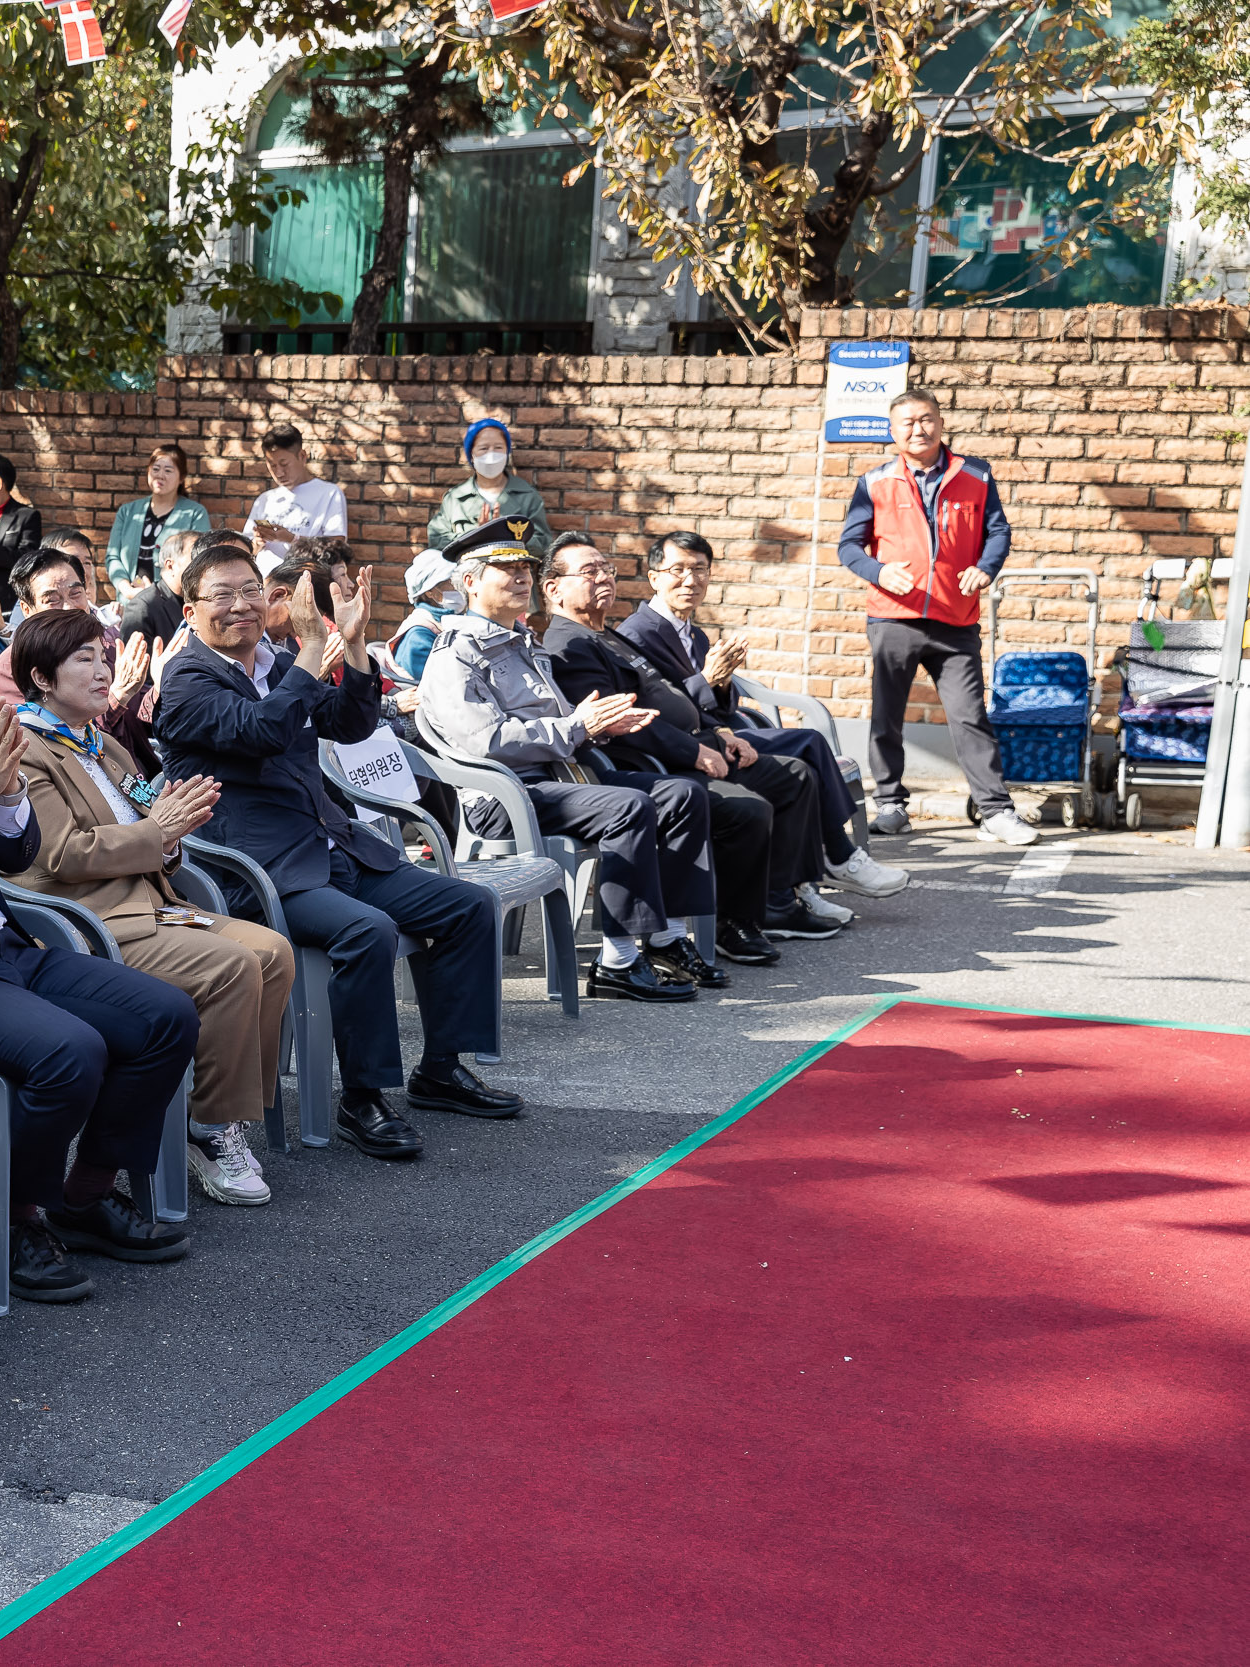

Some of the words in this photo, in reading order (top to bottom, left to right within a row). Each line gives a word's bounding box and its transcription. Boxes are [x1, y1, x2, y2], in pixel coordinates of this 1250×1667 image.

[838, 350, 869, 359] Security
[870, 350, 877, 358] &
[877, 350, 902, 359] Safety
[844, 381, 889, 393] NSOK
[348, 752, 403, 788] 당협위원장
